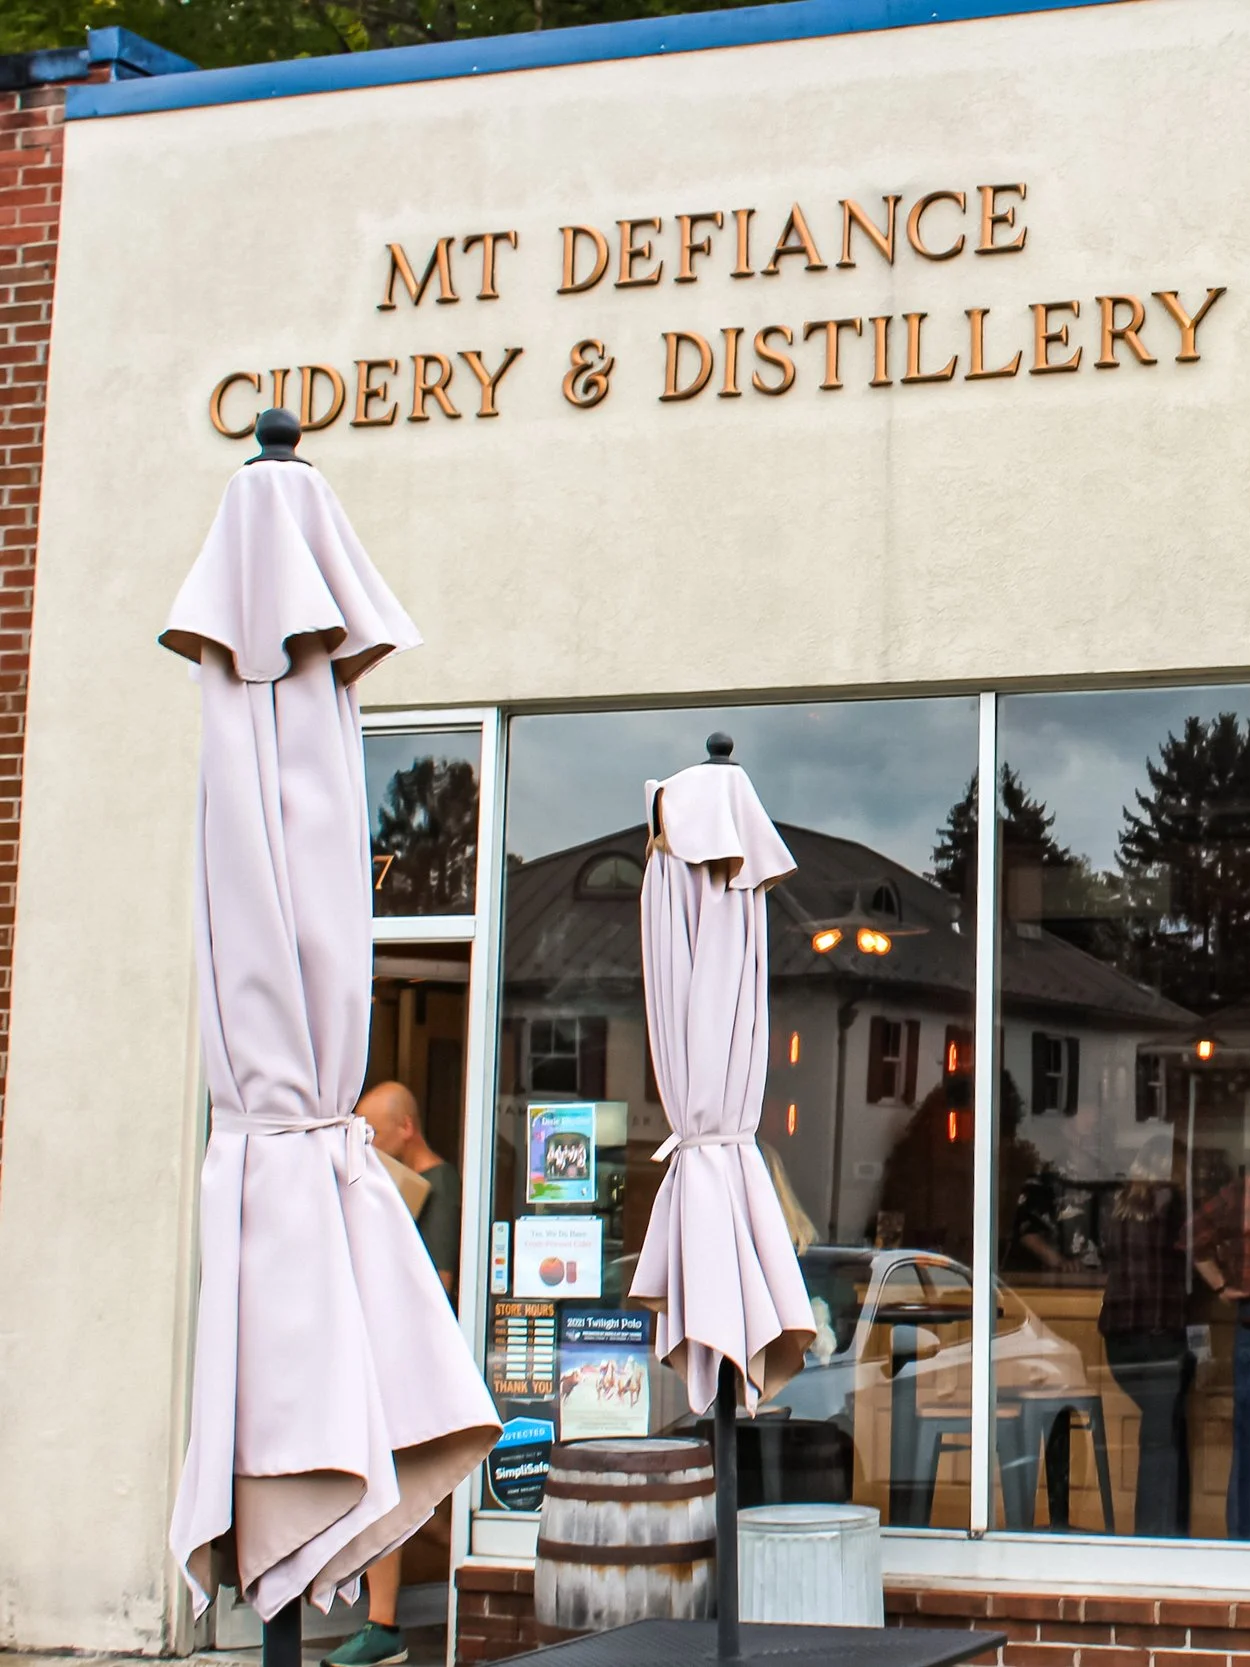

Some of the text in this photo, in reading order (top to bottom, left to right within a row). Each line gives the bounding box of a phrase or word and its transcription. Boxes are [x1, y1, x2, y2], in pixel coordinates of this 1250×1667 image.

[377, 182, 1029, 312] MT DEFIANCE
[208, 285, 1229, 440] CIDERY & DISTILLERY
[372, 854, 395, 890] 7
[495, 1303, 555, 1317] STORE HOURS
[567, 1316, 643, 1330] 2021 Twilight Polo
[494, 1380, 553, 1394] THANK YOU
[495, 1461, 550, 1480] SimpliSafe
